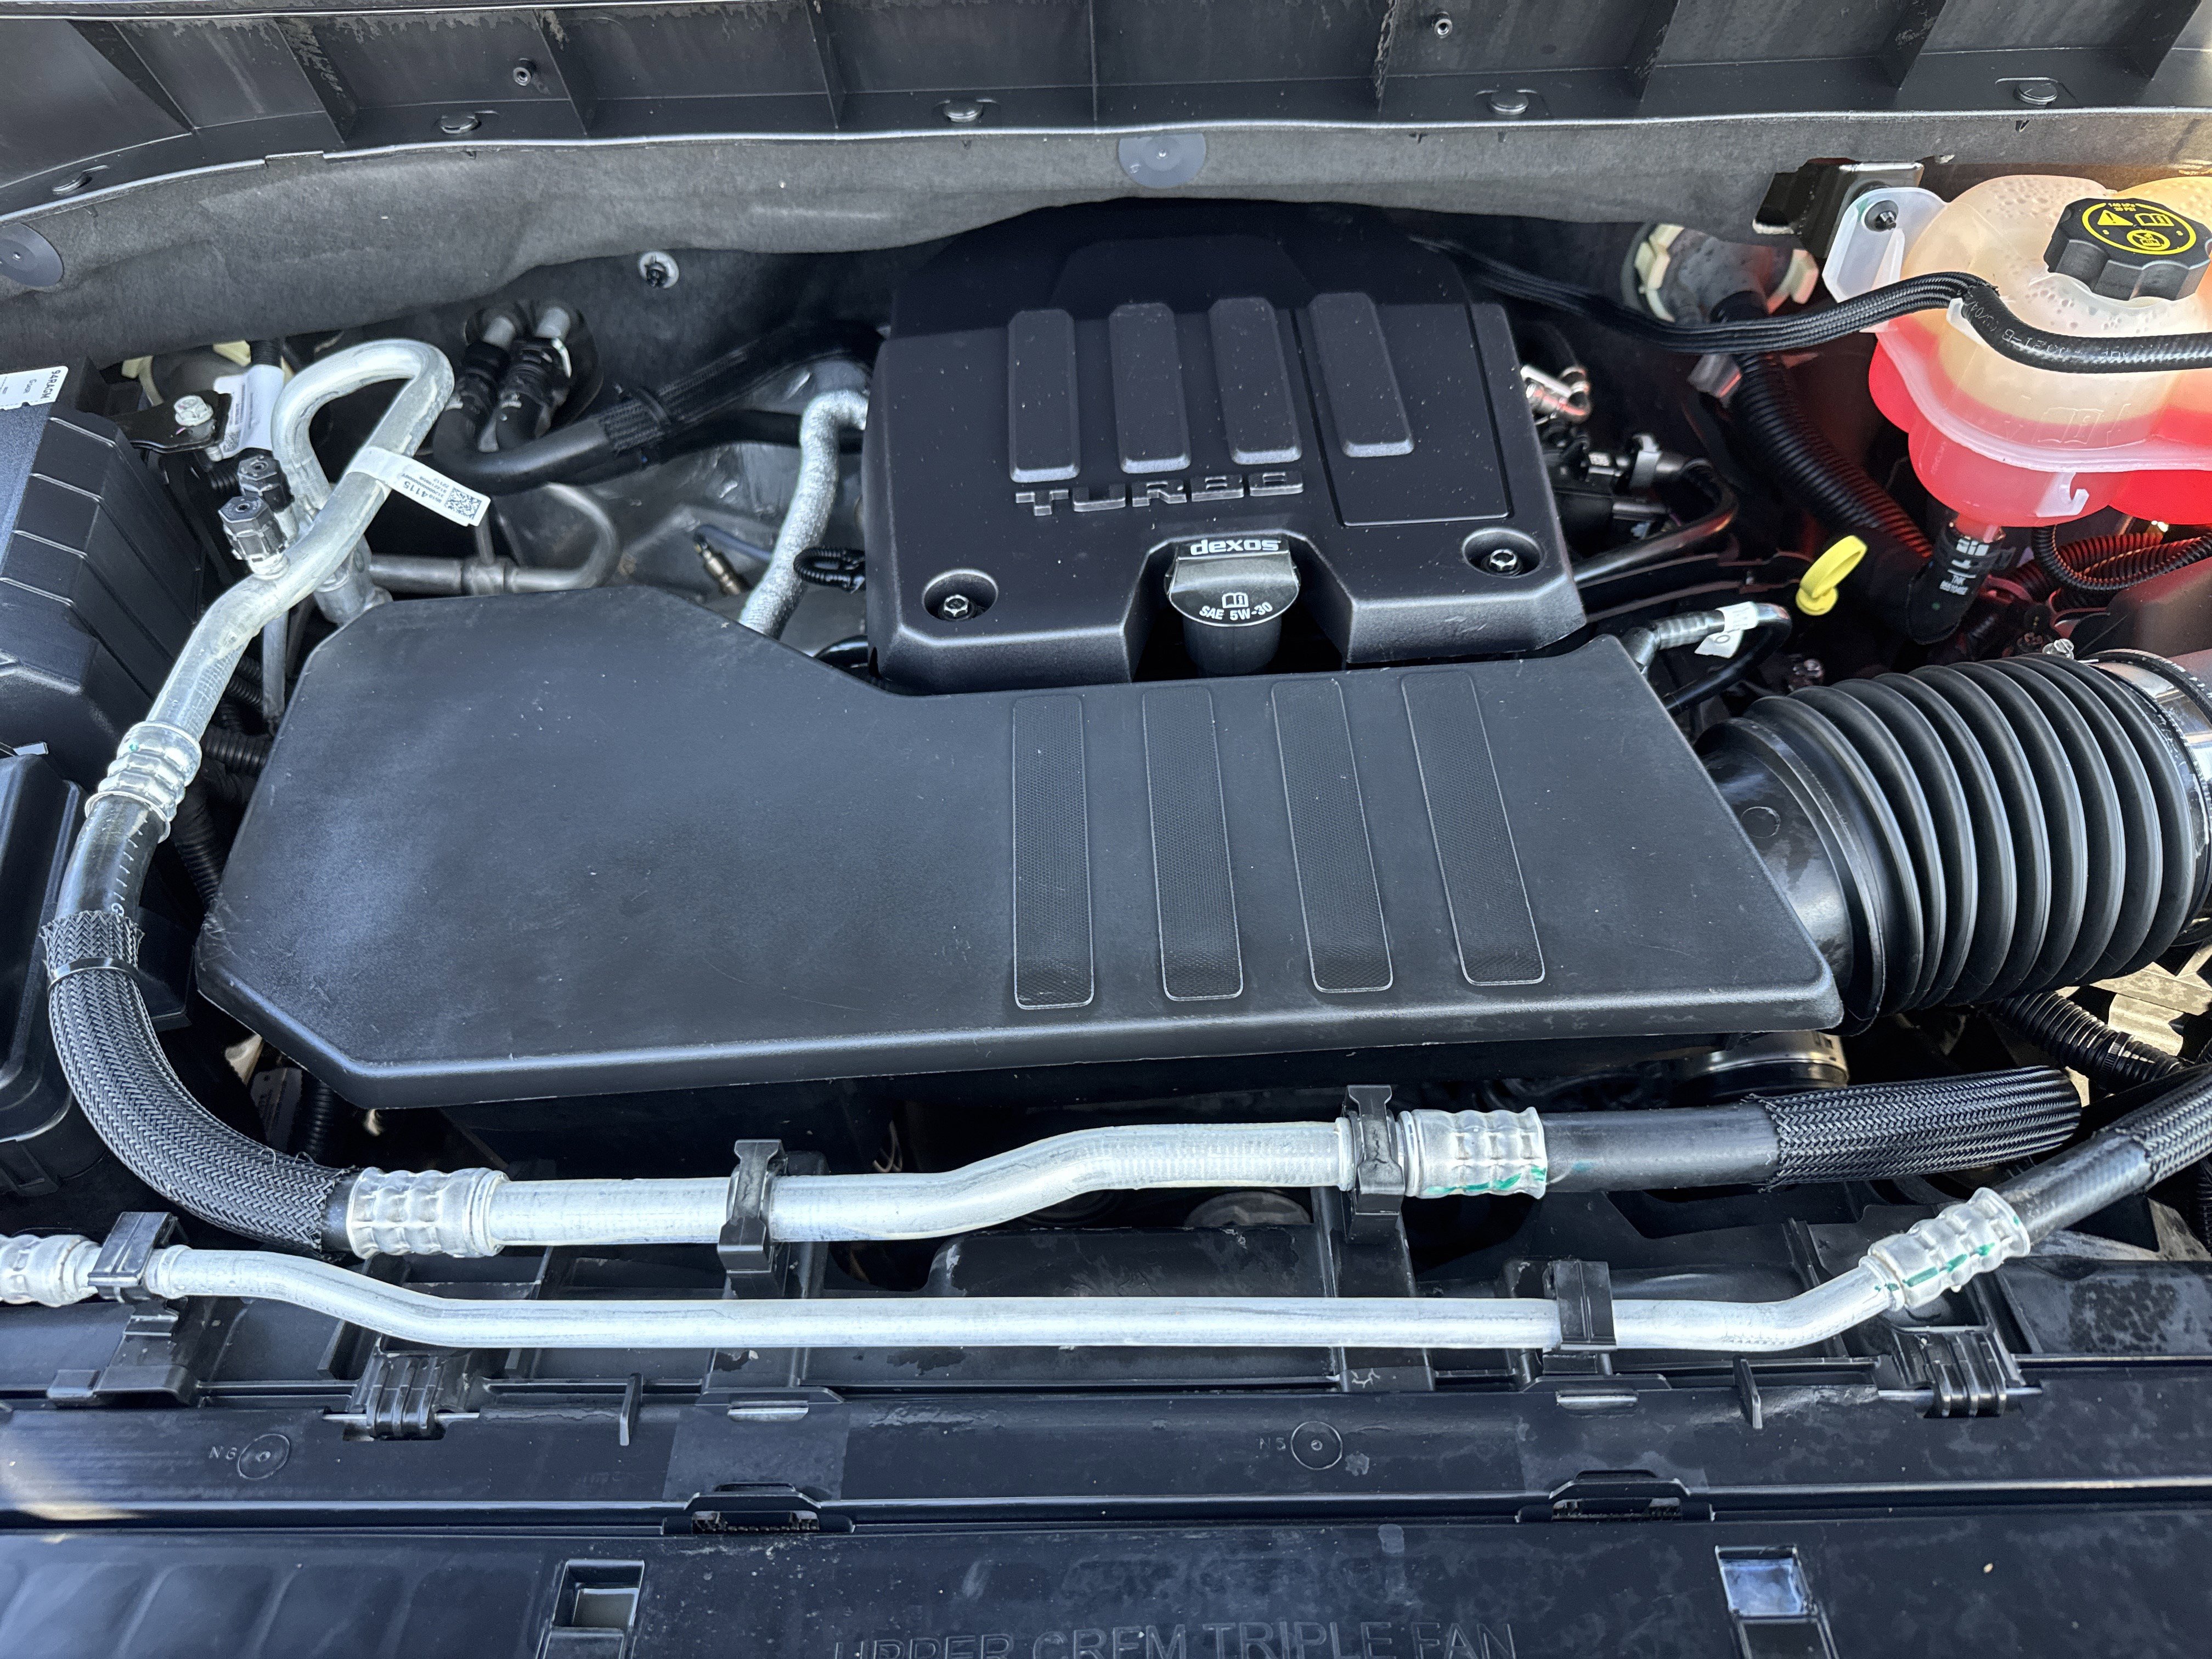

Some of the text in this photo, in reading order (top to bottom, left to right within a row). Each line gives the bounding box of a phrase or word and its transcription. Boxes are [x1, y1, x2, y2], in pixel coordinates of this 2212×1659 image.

[1015, 471, 1304, 516] TURBO
[1190, 539, 1279, 556] dexos
[1199, 602, 1273, 620] SAE 5W-30
[1202, 1621, 1397, 1659] TRIPLE
[1410, 1622, 1516, 1659] FAN
